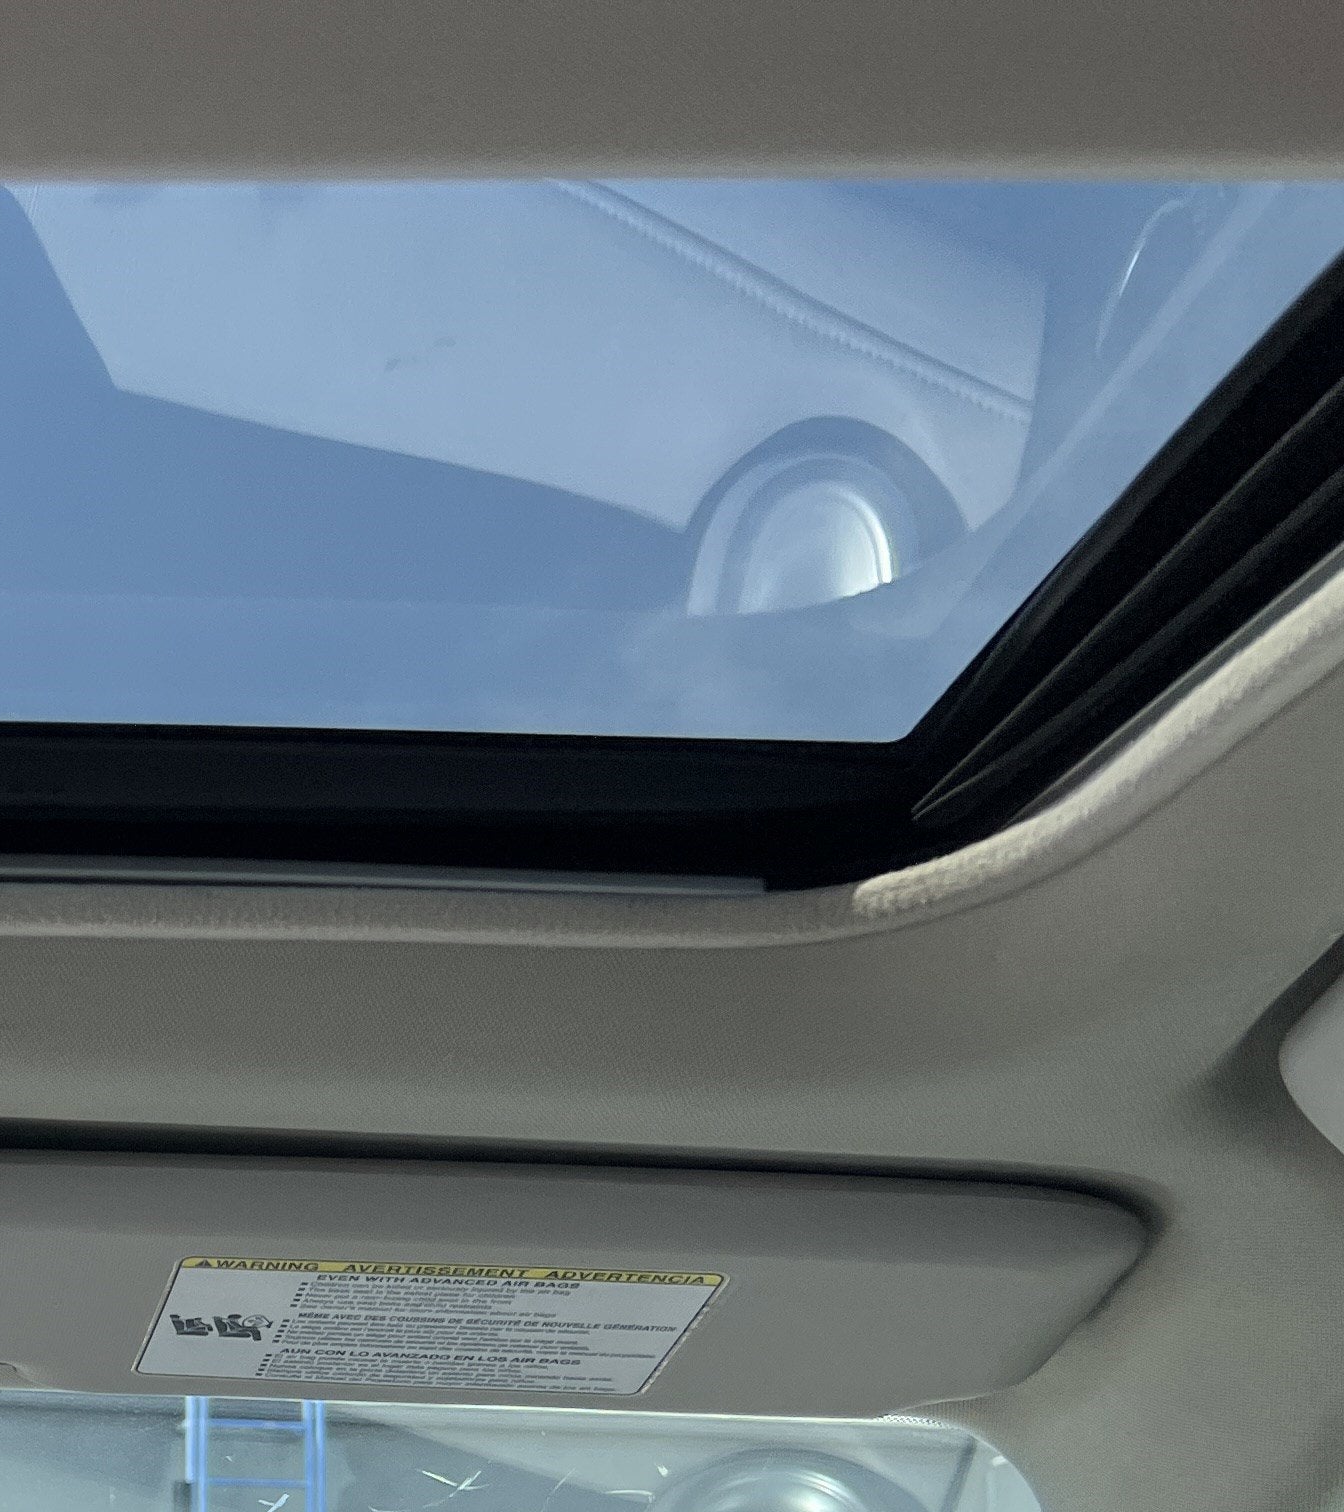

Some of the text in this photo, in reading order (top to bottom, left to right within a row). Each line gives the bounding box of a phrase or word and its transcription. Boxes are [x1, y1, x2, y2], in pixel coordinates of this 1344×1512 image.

[215, 1259, 707, 1285] WARNING AVERTISSEMENT ADVERTENCIA
[316, 1274, 581, 1290] EVEN WITH ADVANCED AIR BAGS
[389, 1316, 445, 1324] COUSSINS
[542, 1322, 601, 1330] NOUVELLE
[372, 1351, 451, 1361] AVANZADO
[538, 1358, 581, 1366] BAGS
